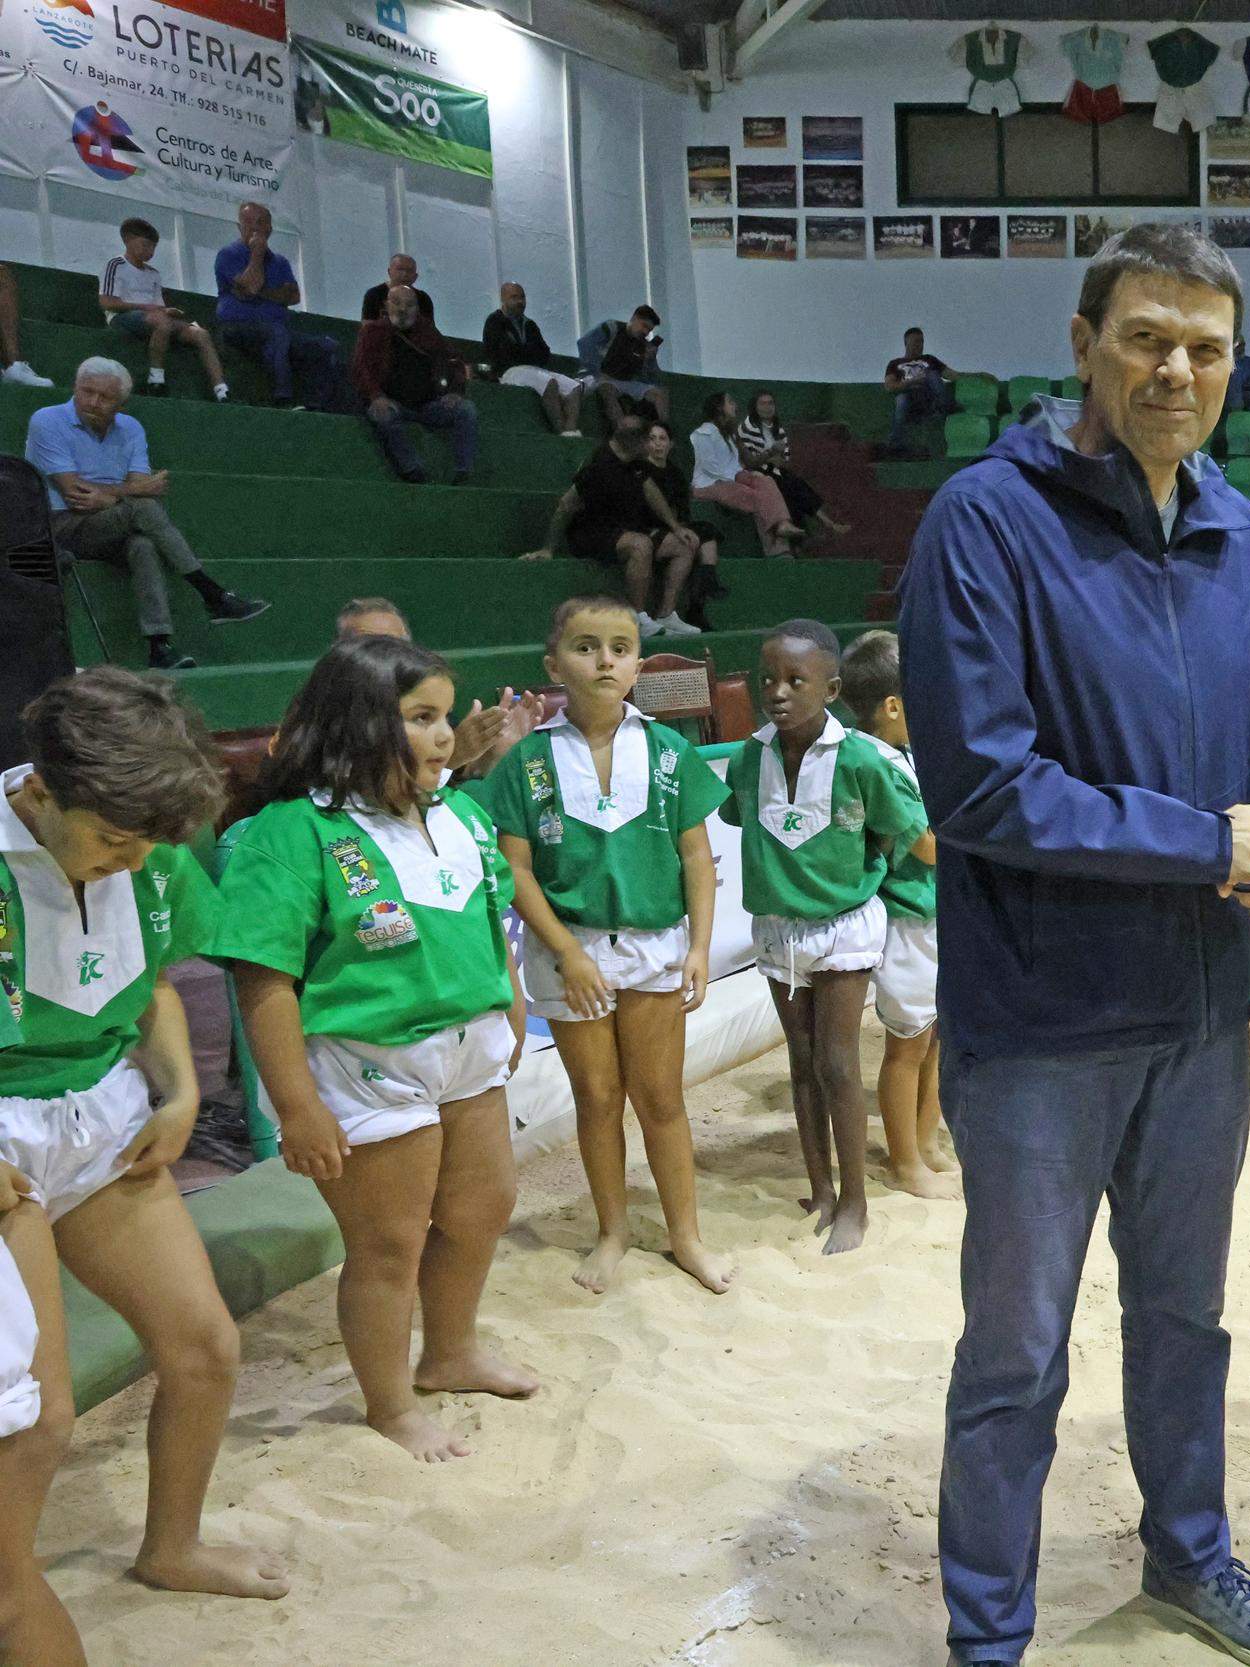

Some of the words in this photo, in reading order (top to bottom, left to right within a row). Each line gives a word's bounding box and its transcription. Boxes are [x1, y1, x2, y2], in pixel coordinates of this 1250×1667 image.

[113, 5, 283, 88] LOTERIAS
[346, 22, 397, 51] BEACH
[400, 43, 438, 65] MATE
[88, 65, 146, 94] Bajamar,
[198, 98, 218, 113] 928
[222, 105, 243, 120] 515
[247, 112, 266, 127] 116
[116, 46, 180, 74] PUERTO
[190, 70, 216, 86] DEL
[225, 80, 284, 105] CARMEN
[156, 127, 215, 156] Centros
[221, 145, 238, 161] de
[157, 148, 212, 176] Cultura
[214, 166, 222, 181] y
[225, 164, 280, 191] Turismo
